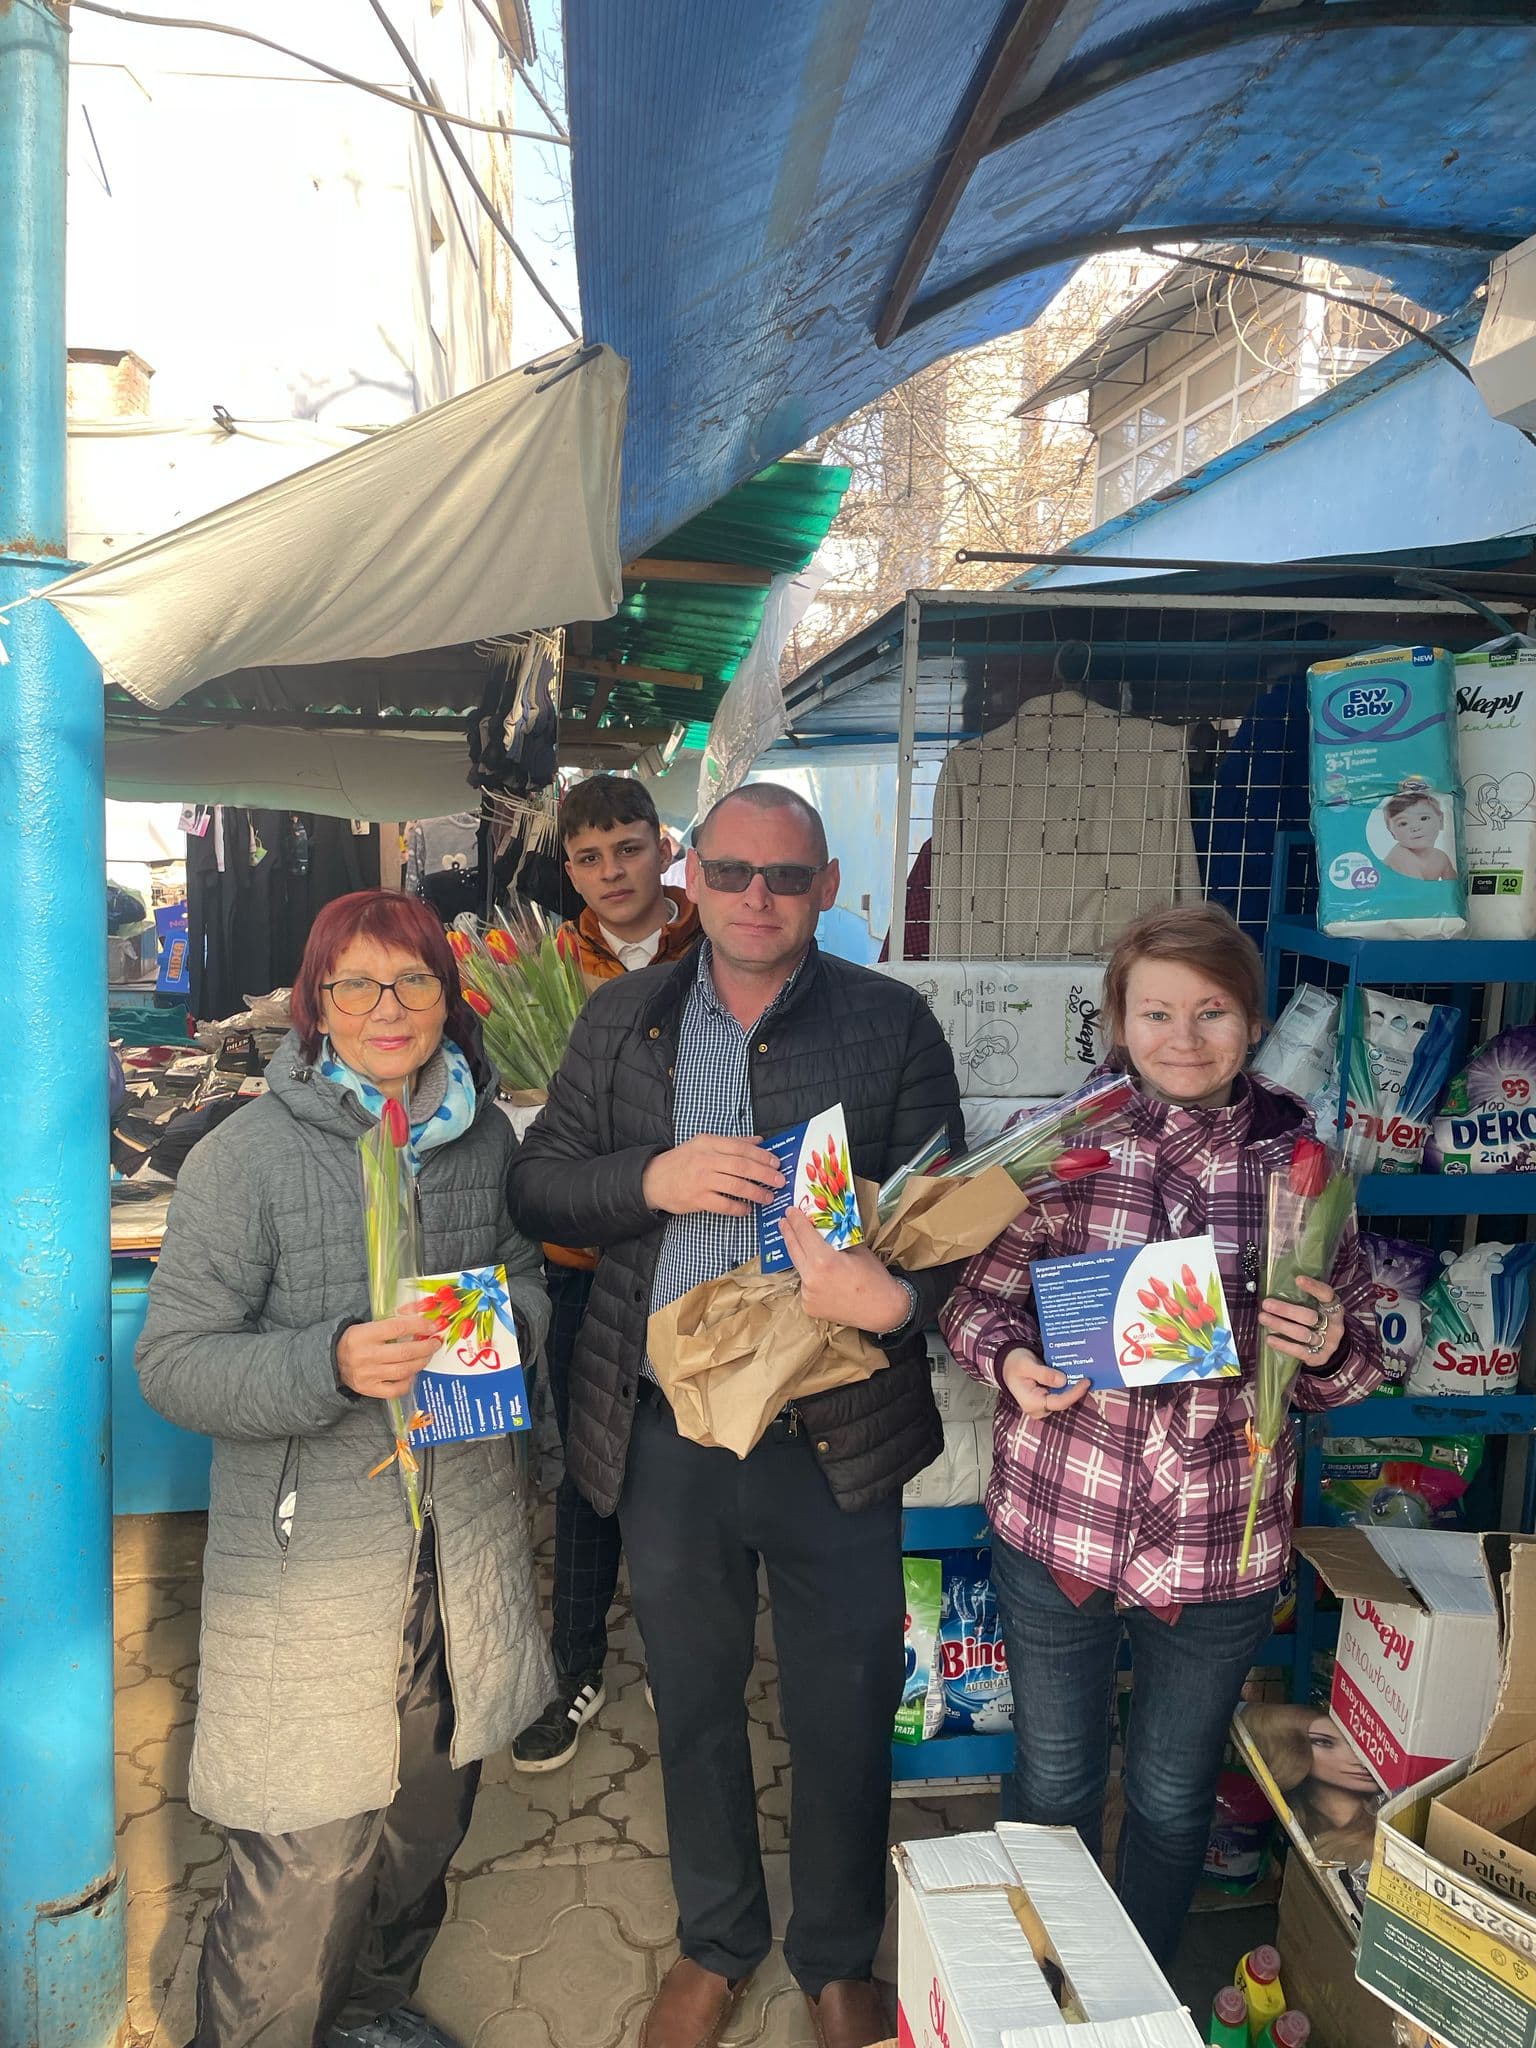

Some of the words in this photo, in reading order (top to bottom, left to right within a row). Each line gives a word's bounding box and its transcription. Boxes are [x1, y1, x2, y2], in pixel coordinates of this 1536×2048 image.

[1413, 654, 1434, 663] NEW
[1342, 701, 1394, 719] Baby
[1348, 687, 1388, 705] Evy
[1456, 685, 1524, 719] Sleepy
[1334, 858, 1351, 882] 5
[1355, 870, 1378, 884] 46
[1502, 878, 1518, 888] 40
[1075, 999, 1105, 1066] Sleepy
[1378, 1079, 1408, 1097] 100
[1501, 1078, 1530, 1099] 99
[1332, 1100, 1425, 1149] Savex
[1119, 1322, 1145, 1367] 8
[1454, 1331, 1480, 1345] 100
[1432, 1341, 1521, 1377] Savex
[940, 1637, 1009, 1681] Bing
[1339, 1678, 1359, 1710] Baby
[1358, 1700, 1376, 1732] Wet
[1375, 1721, 1400, 1765] Wipes
[1348, 1708, 1386, 1767] 12x120
[1462, 1849, 1536, 1907] Palette
